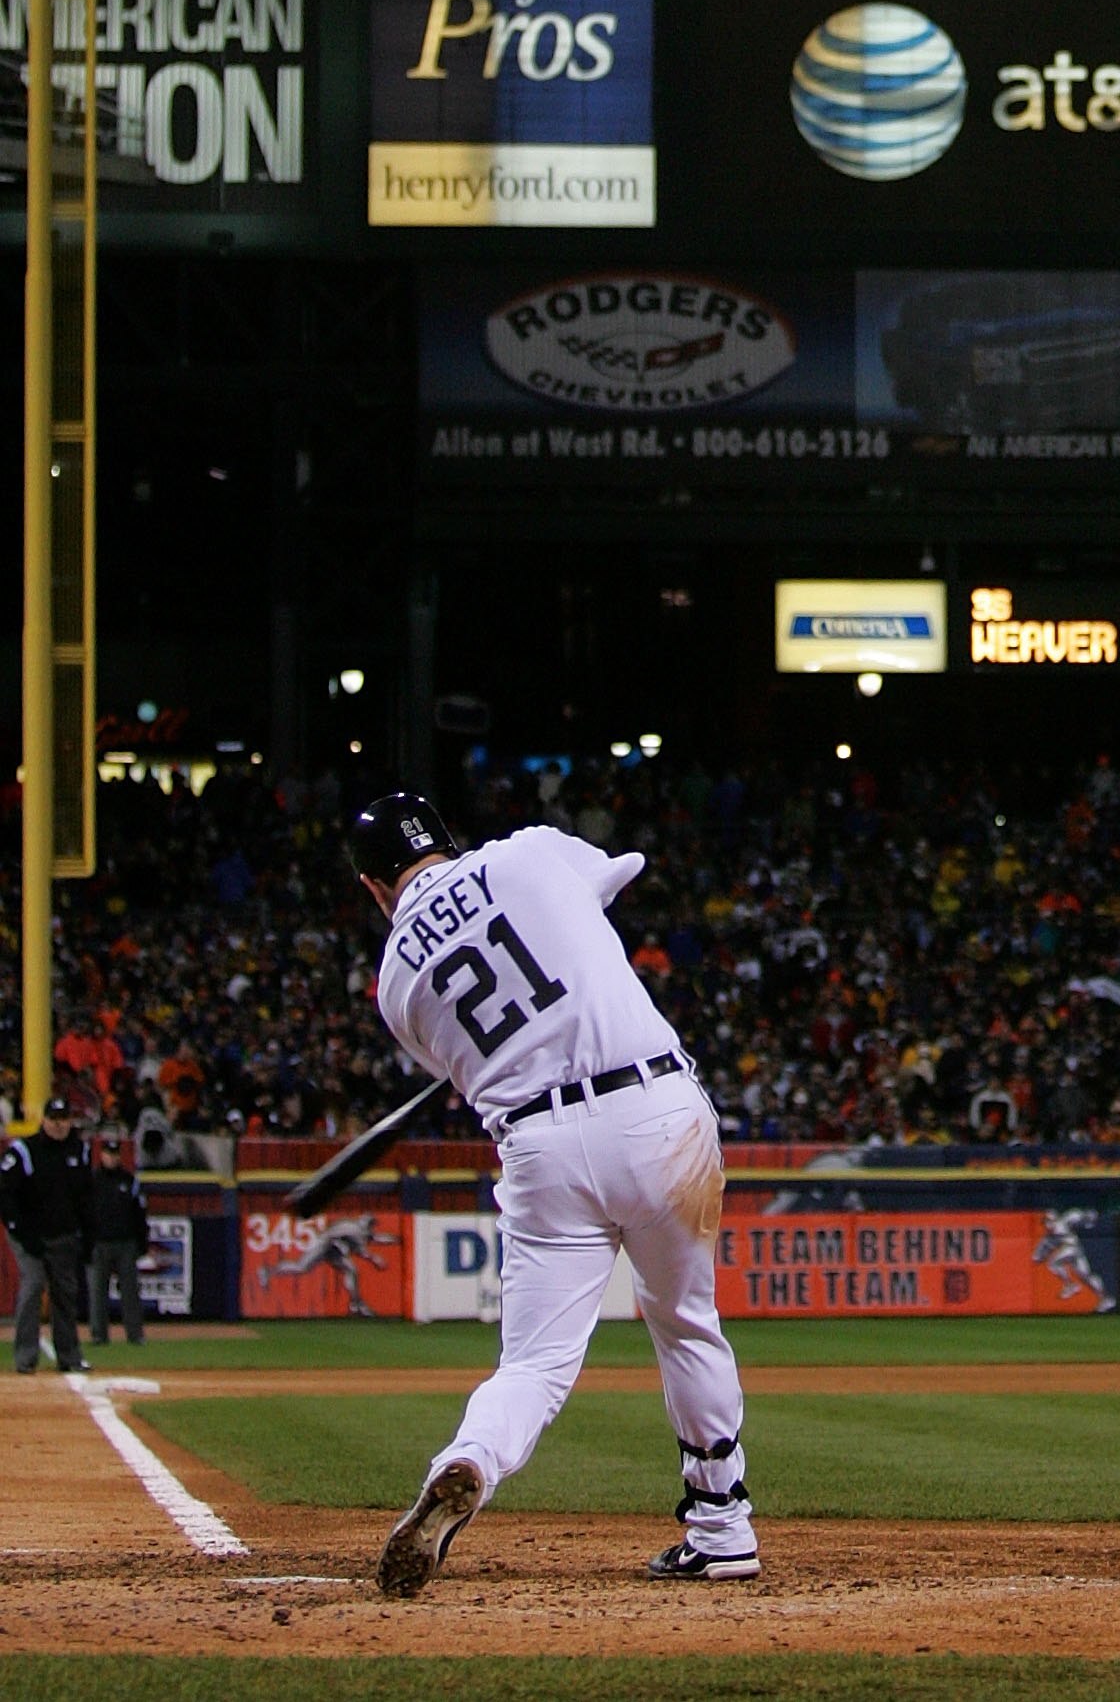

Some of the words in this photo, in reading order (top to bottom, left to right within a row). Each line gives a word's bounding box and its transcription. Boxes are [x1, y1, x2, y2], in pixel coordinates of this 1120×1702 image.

[384, 165, 639, 217] henryford.com
[505, 282, 771, 340] RODGERS
[528, 370, 748, 404] CHEVROLET
[432, 429, 501, 457] Allen
[511, 430, 540, 457] at
[548, 430, 612, 457] West
[621, 430, 665, 457] Rd.
[971, 621, 1118, 663] WEAVER
[400, 817, 423, 837] 21
[397, 864, 495, 972] CASEY
[432, 912, 569, 1058] 21
[750, 1229, 845, 1264] TEAM
[858, 1229, 990, 1264] BEHIND
[747, 1271, 811, 1305] THE
[823, 1270, 929, 1305] TEAM.
